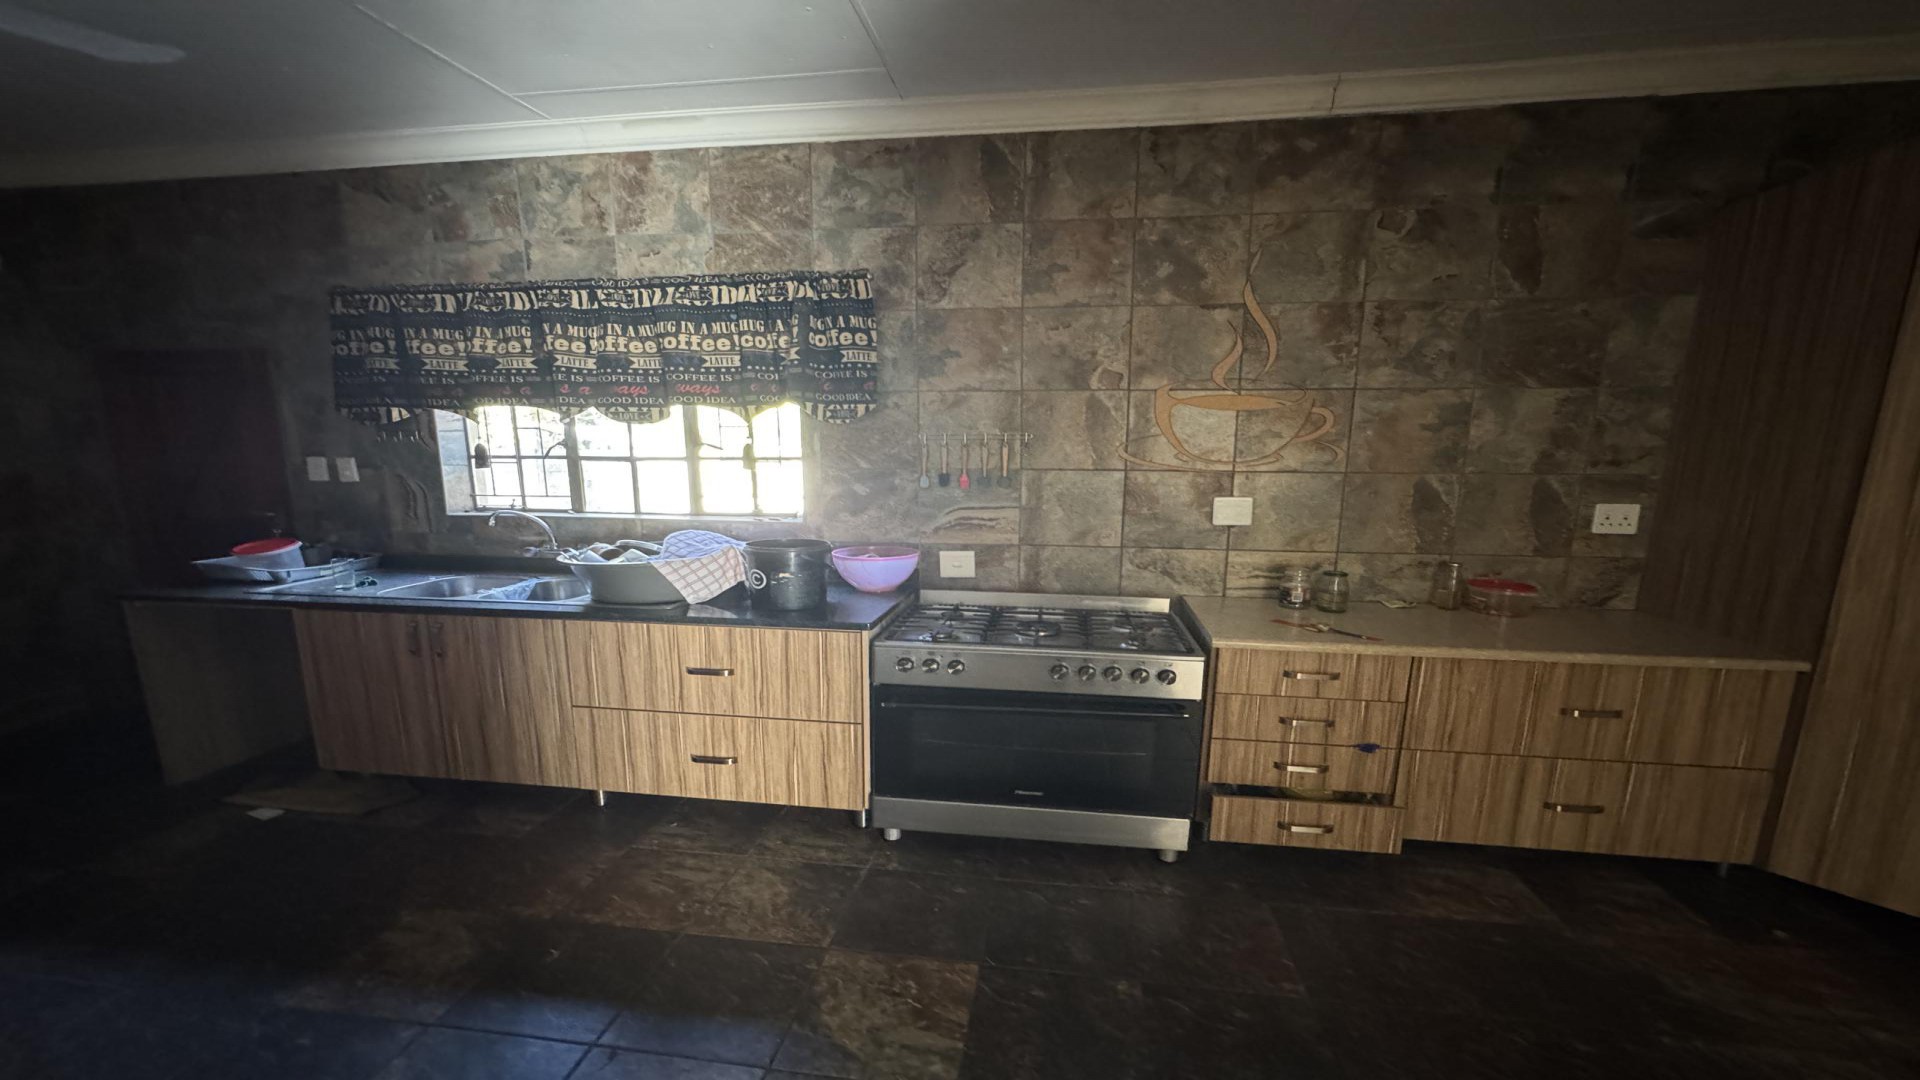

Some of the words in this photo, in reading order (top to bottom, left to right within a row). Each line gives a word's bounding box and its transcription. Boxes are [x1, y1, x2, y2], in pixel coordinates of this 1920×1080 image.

[680, 320, 696, 334] IN
[700, 322, 709, 335] A
[740, 318, 765, 333] HUG
[836, 315, 846, 328] A
[849, 315, 877, 329] MUG
[432, 327, 464, 341] MUG
[475, 325, 492, 339] IN
[552, 322, 562, 335] A
[607, 322, 623, 336] IN
[626, 325, 636, 337] A
[637, 324, 655, 337] MU
[709, 356, 737, 366] LATTE
[845, 350, 872, 361] LATTE
[561, 356, 589, 368] LATTE
[571, 374, 583, 383] IS
[666, 373, 717, 382] COFFEE
[720, 374, 733, 382] IS
[855, 370, 869, 378] IS
[649, 376, 660, 384] IS
[676, 383, 721, 397] ways
[560, 396, 586, 405] DEA
[635, 397, 665, 405] IDEA
[706, 395, 736, 404] IDEA
